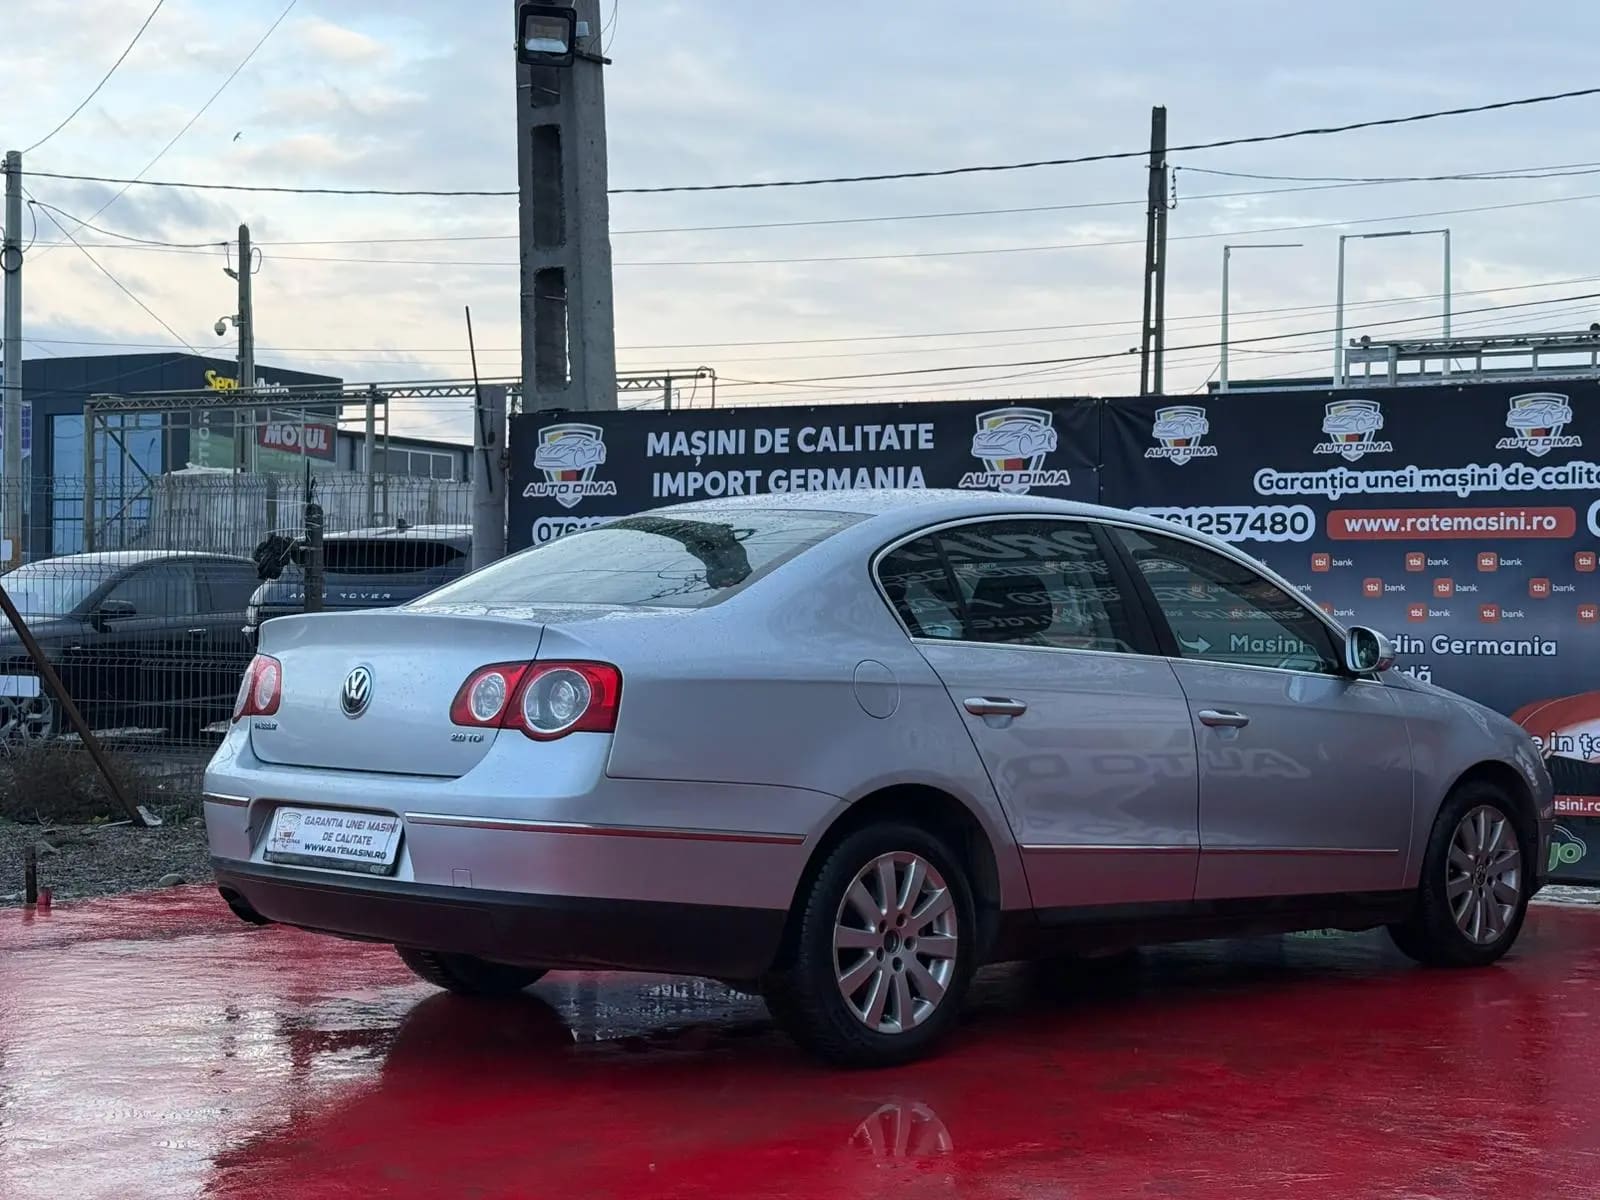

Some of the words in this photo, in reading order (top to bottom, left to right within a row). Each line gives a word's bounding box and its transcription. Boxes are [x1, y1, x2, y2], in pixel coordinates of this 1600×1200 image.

[647, 430, 746, 466] MAȘINI
[754, 428, 790, 454] DE
[797, 423, 934, 452] CALITATE
[1313, 443, 1352, 454] AUTO
[1356, 441, 1393, 452] DIMA
[1496, 437, 1538, 449] AUTO
[1542, 435, 1582, 447] DIMA
[1144, 447, 1180, 458] AUTO
[1183, 446, 1217, 457] DIMA
[653, 470, 762, 497] IMPORT
[768, 466, 927, 493] GERMANIA
[959, 472, 1014, 487] AUTO
[1018, 470, 1071, 486] DIMA
[1258, 471, 1359, 496] Garanția
[1366, 470, 1414, 488] unei
[1422, 468, 1498, 493] mașini
[1505, 467, 1535, 486] de
[523, 483, 570, 497] AUTO
[572, 481, 617, 496] DIMA
[1150, 511, 1309, 535] 1257480
[1344, 511, 1557, 532] www.ratemasini.ro
[1315, 558, 1326, 566] tbi
[1332, 558, 1353, 567] bank
[1409, 558, 1421, 566] tbi
[1427, 558, 1449, 566] bank
[1482, 558, 1494, 566] tbi
[1500, 558, 1522, 566] bank
[1579, 557, 1591, 565] tbi
[1385, 583, 1407, 592] bank
[1438, 584, 1450, 592] tbi
[1456, 584, 1478, 592] bank
[1533, 584, 1545, 592] tbi
[1553, 584, 1575, 592] bank
[1334, 608, 1355, 616] bank
[1411, 609, 1423, 617] tbi
[1429, 609, 1450, 617] bank
[1483, 609, 1495, 617] tbi
[1502, 609, 1524, 618] bank
[1581, 610, 1594, 618] tbi
[1390, 635, 1425, 653] din
[1432, 634, 1557, 655] Germania
[1550, 732, 1574, 752] in
[304, 816, 344, 828] GARANTIA
[346, 820, 365, 830] UNEI
[367, 822, 398, 833] MASINI
[322, 831, 334, 842] DE
[335, 833, 372, 845] CALITATE
